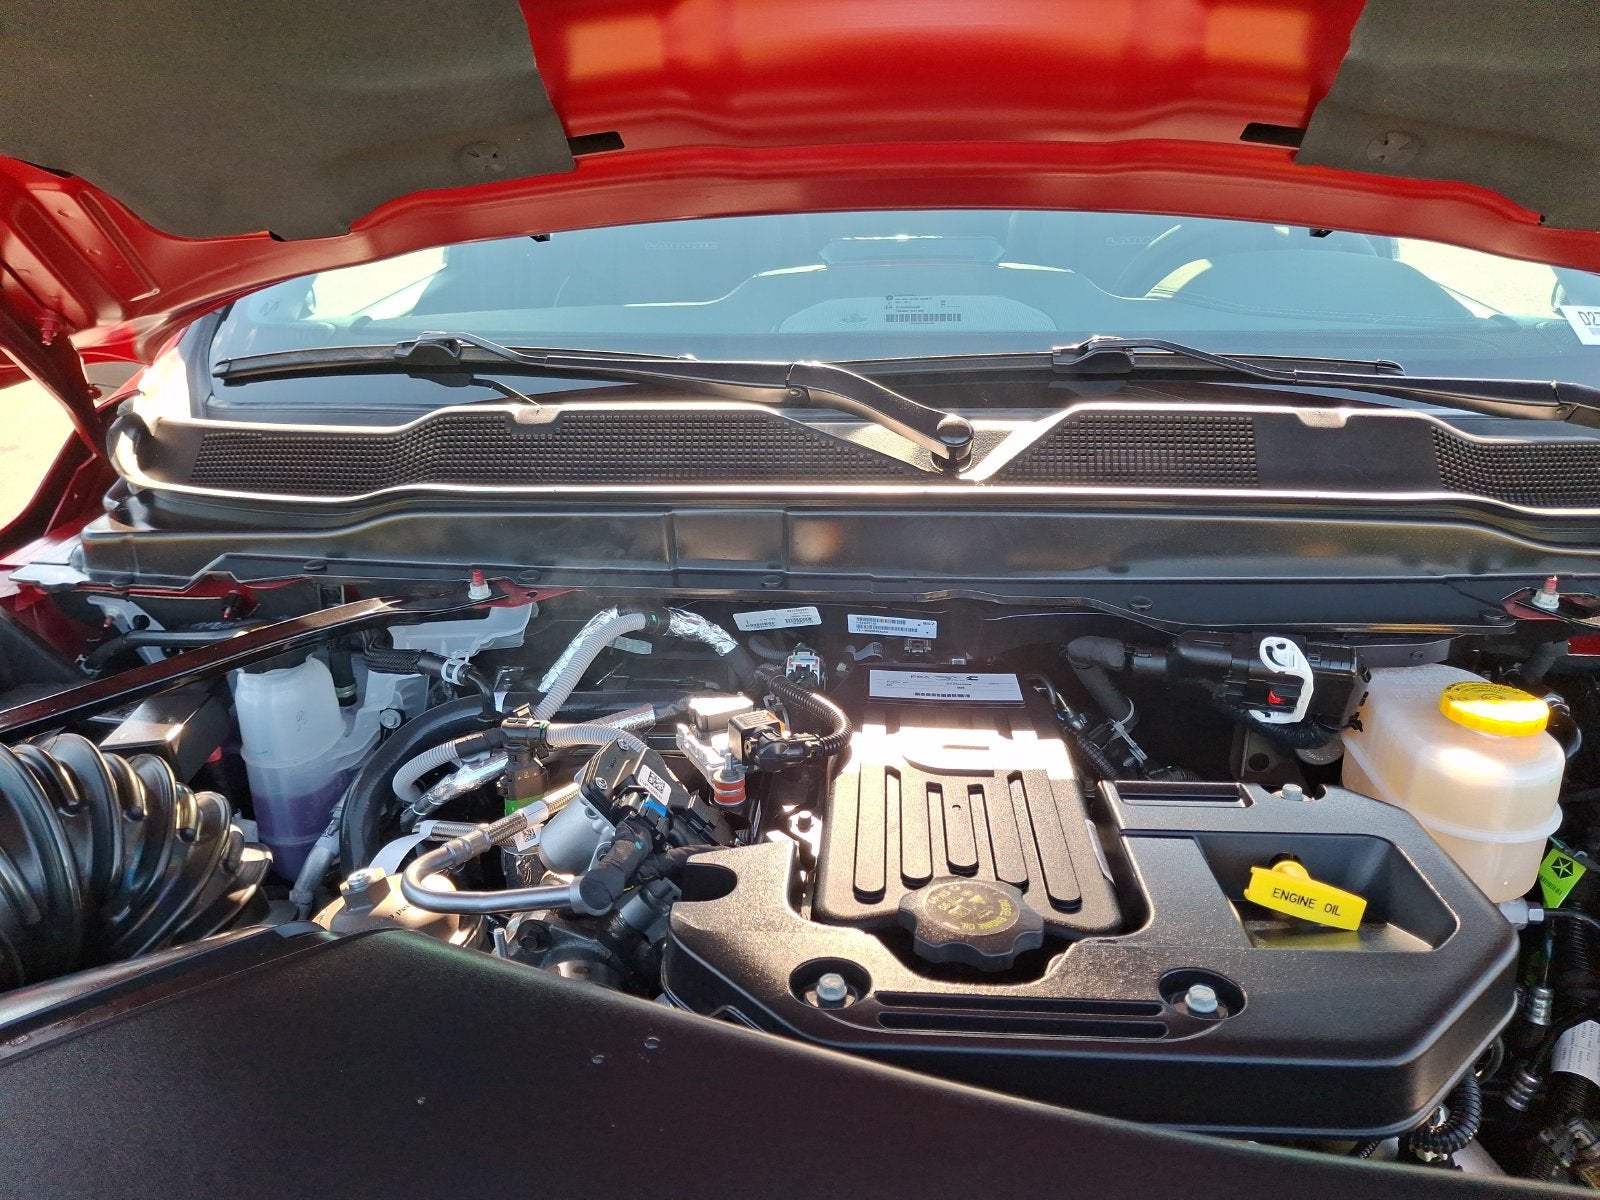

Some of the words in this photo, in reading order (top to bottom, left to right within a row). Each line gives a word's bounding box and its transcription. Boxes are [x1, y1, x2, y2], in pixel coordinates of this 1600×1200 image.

[1272, 887, 1317, 909] ENGINE
[1324, 902, 1342, 917] OIL
[961, 922, 976, 930] OIL
